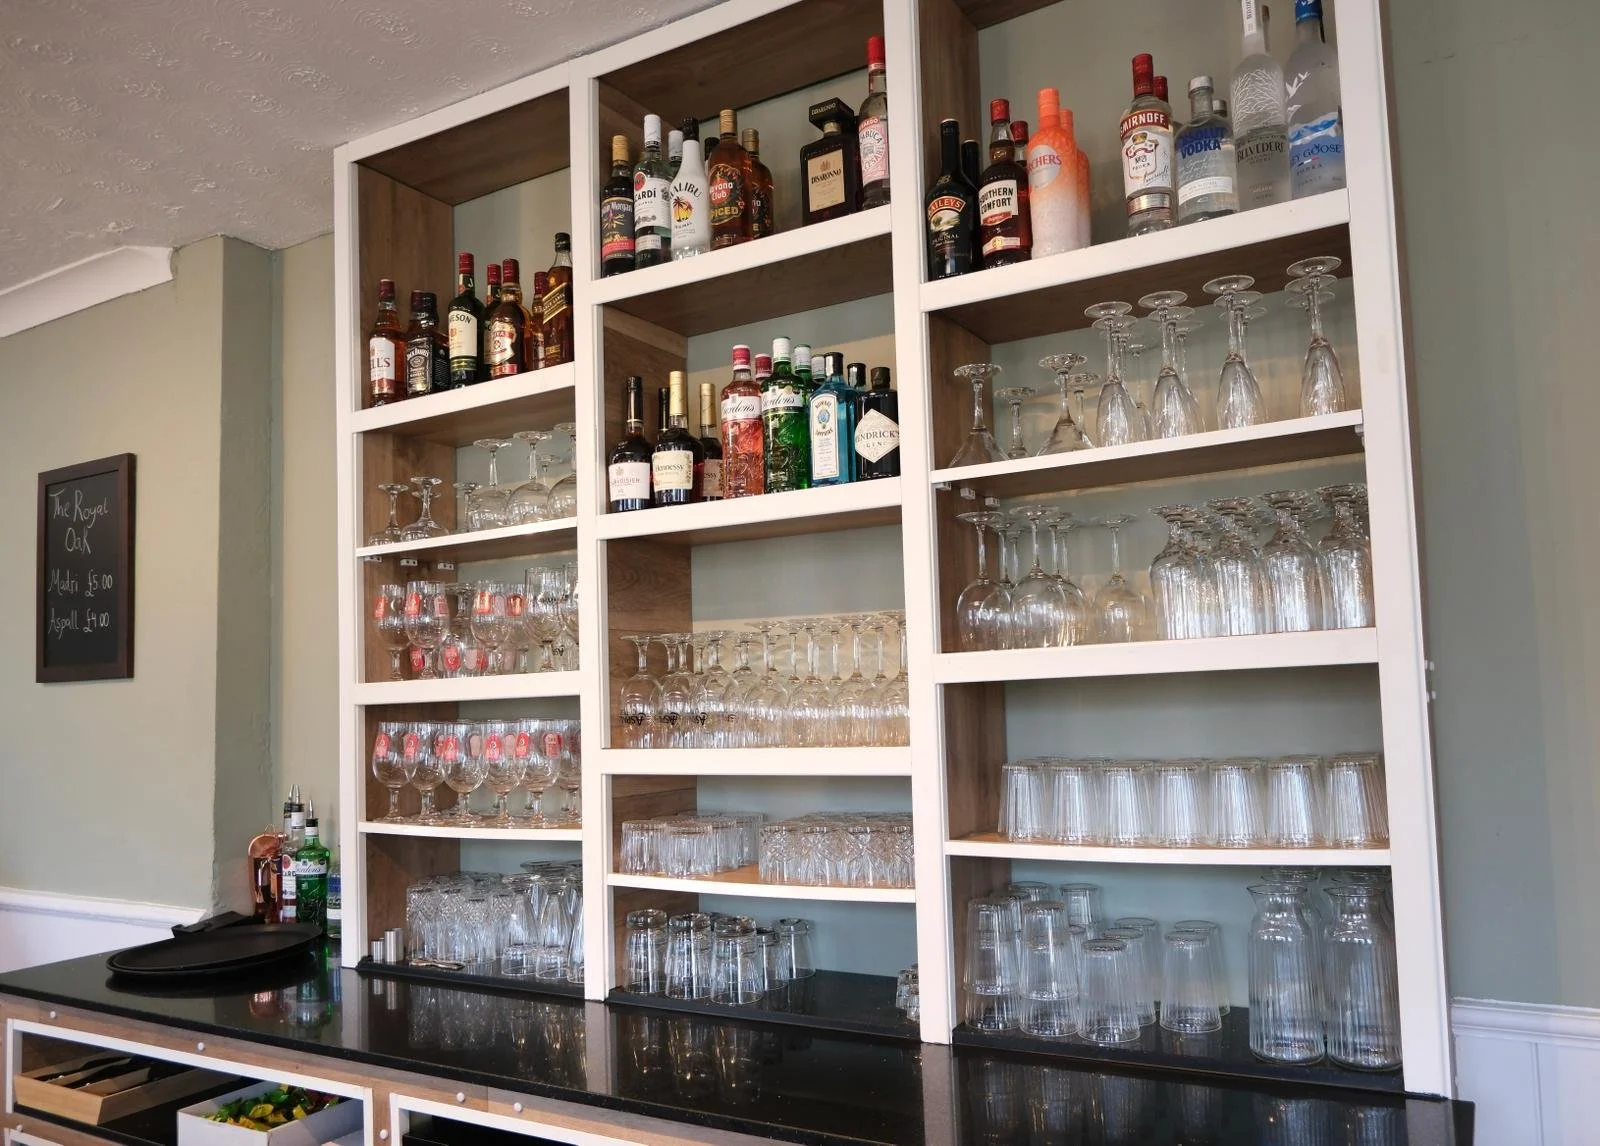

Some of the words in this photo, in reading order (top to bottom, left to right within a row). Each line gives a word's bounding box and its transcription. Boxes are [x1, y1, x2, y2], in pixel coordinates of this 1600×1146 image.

[1181, 138, 1221, 159] VODKA
[1302, 143, 1341, 158] GOOSE
[1027, 154, 1062, 173] RCHERS
[811, 168, 841, 185] DISARONNO
[635, 188, 657, 200] CARDÍ
[980, 187, 1013, 203] SOUTHERN
[711, 206, 738, 217] ICED
[930, 198, 961, 211] AILEYS
[981, 197, 1011, 214] COMFORT
[448, 313, 472, 324] ESON
[369, 356, 391, 369] LL'S
[50, 488, 70, 519] The
[73, 489, 109, 529] Royal
[65, 527, 91, 554] Oak
[48, 607, 79, 640] Aspall
